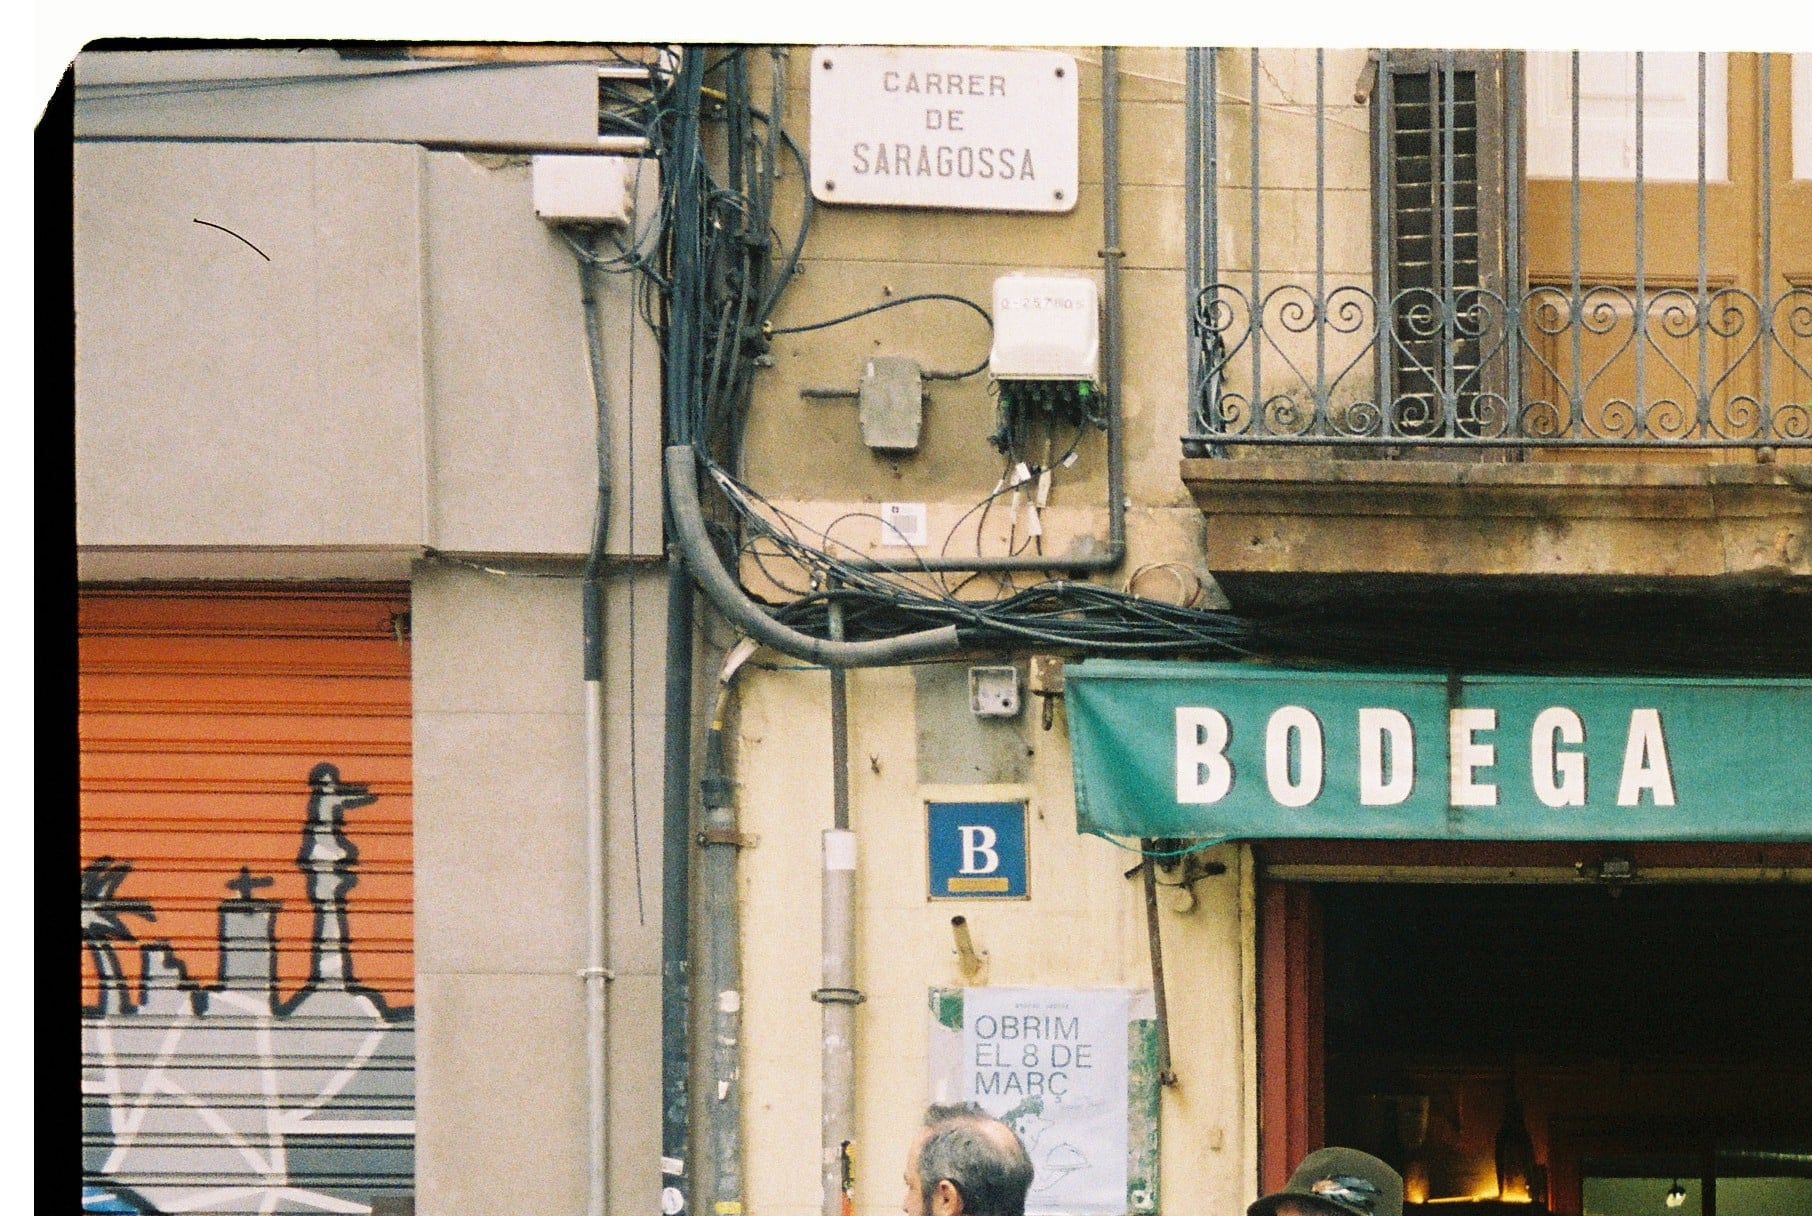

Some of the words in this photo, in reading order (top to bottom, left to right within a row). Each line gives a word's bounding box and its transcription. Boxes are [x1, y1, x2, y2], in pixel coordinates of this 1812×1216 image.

[883, 71, 1006, 96] CARRER
[926, 109, 964, 131] DE
[853, 142, 1035, 181] SARAGOSSA
[1174, 705, 1677, 808] BODEGA
[958, 824, 1001, 875] B
[974, 1014, 1080, 1041] OBRIM
[975, 1042, 1012, 1068] EL
[1021, 1043, 1040, 1068] 8
[1050, 1043, 1093, 1069] DE
[974, 1071, 1069, 1104] MARÇ
